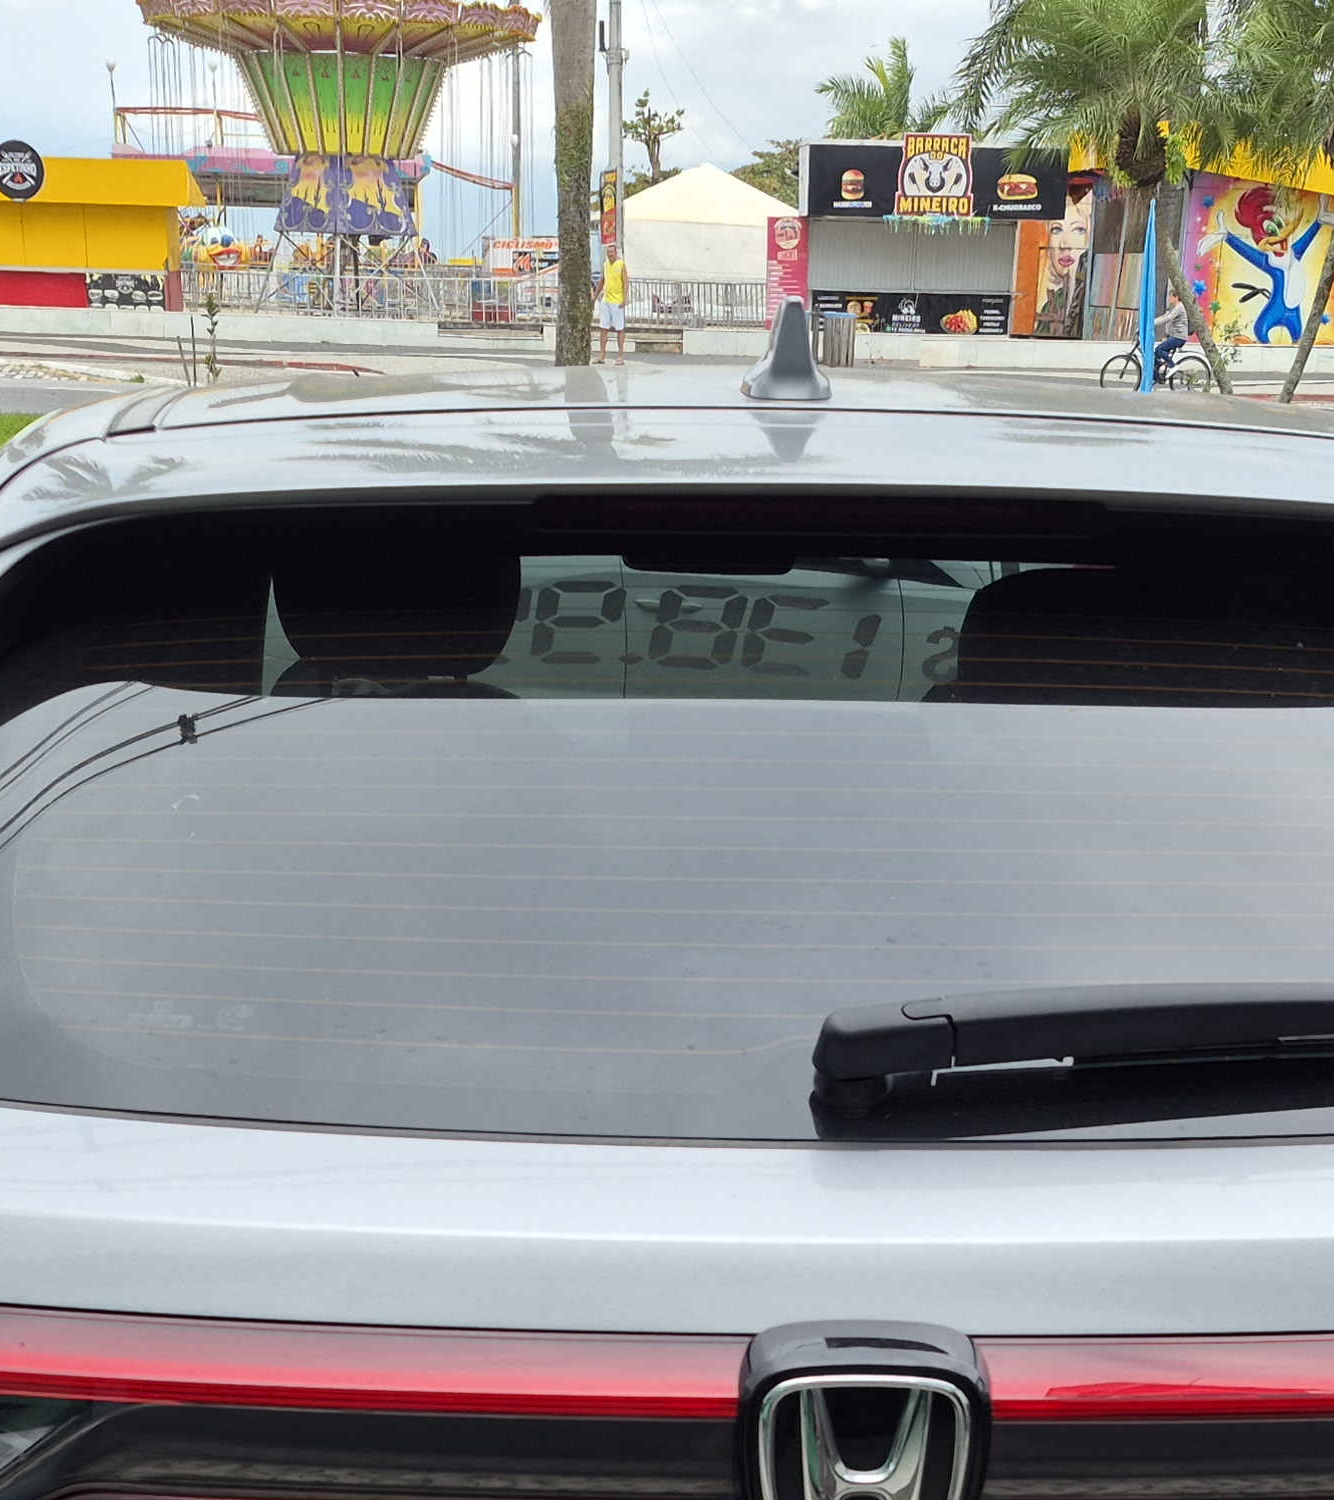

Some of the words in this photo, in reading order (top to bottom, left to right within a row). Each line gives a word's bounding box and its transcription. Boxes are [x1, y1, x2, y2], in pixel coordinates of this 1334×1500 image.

[907, 136, 967, 160] BARRACA
[929, 151, 945, 160] DO
[899, 196, 969, 214] MINEIRO
[992, 203, 1043, 212] X-CHURRASCO
